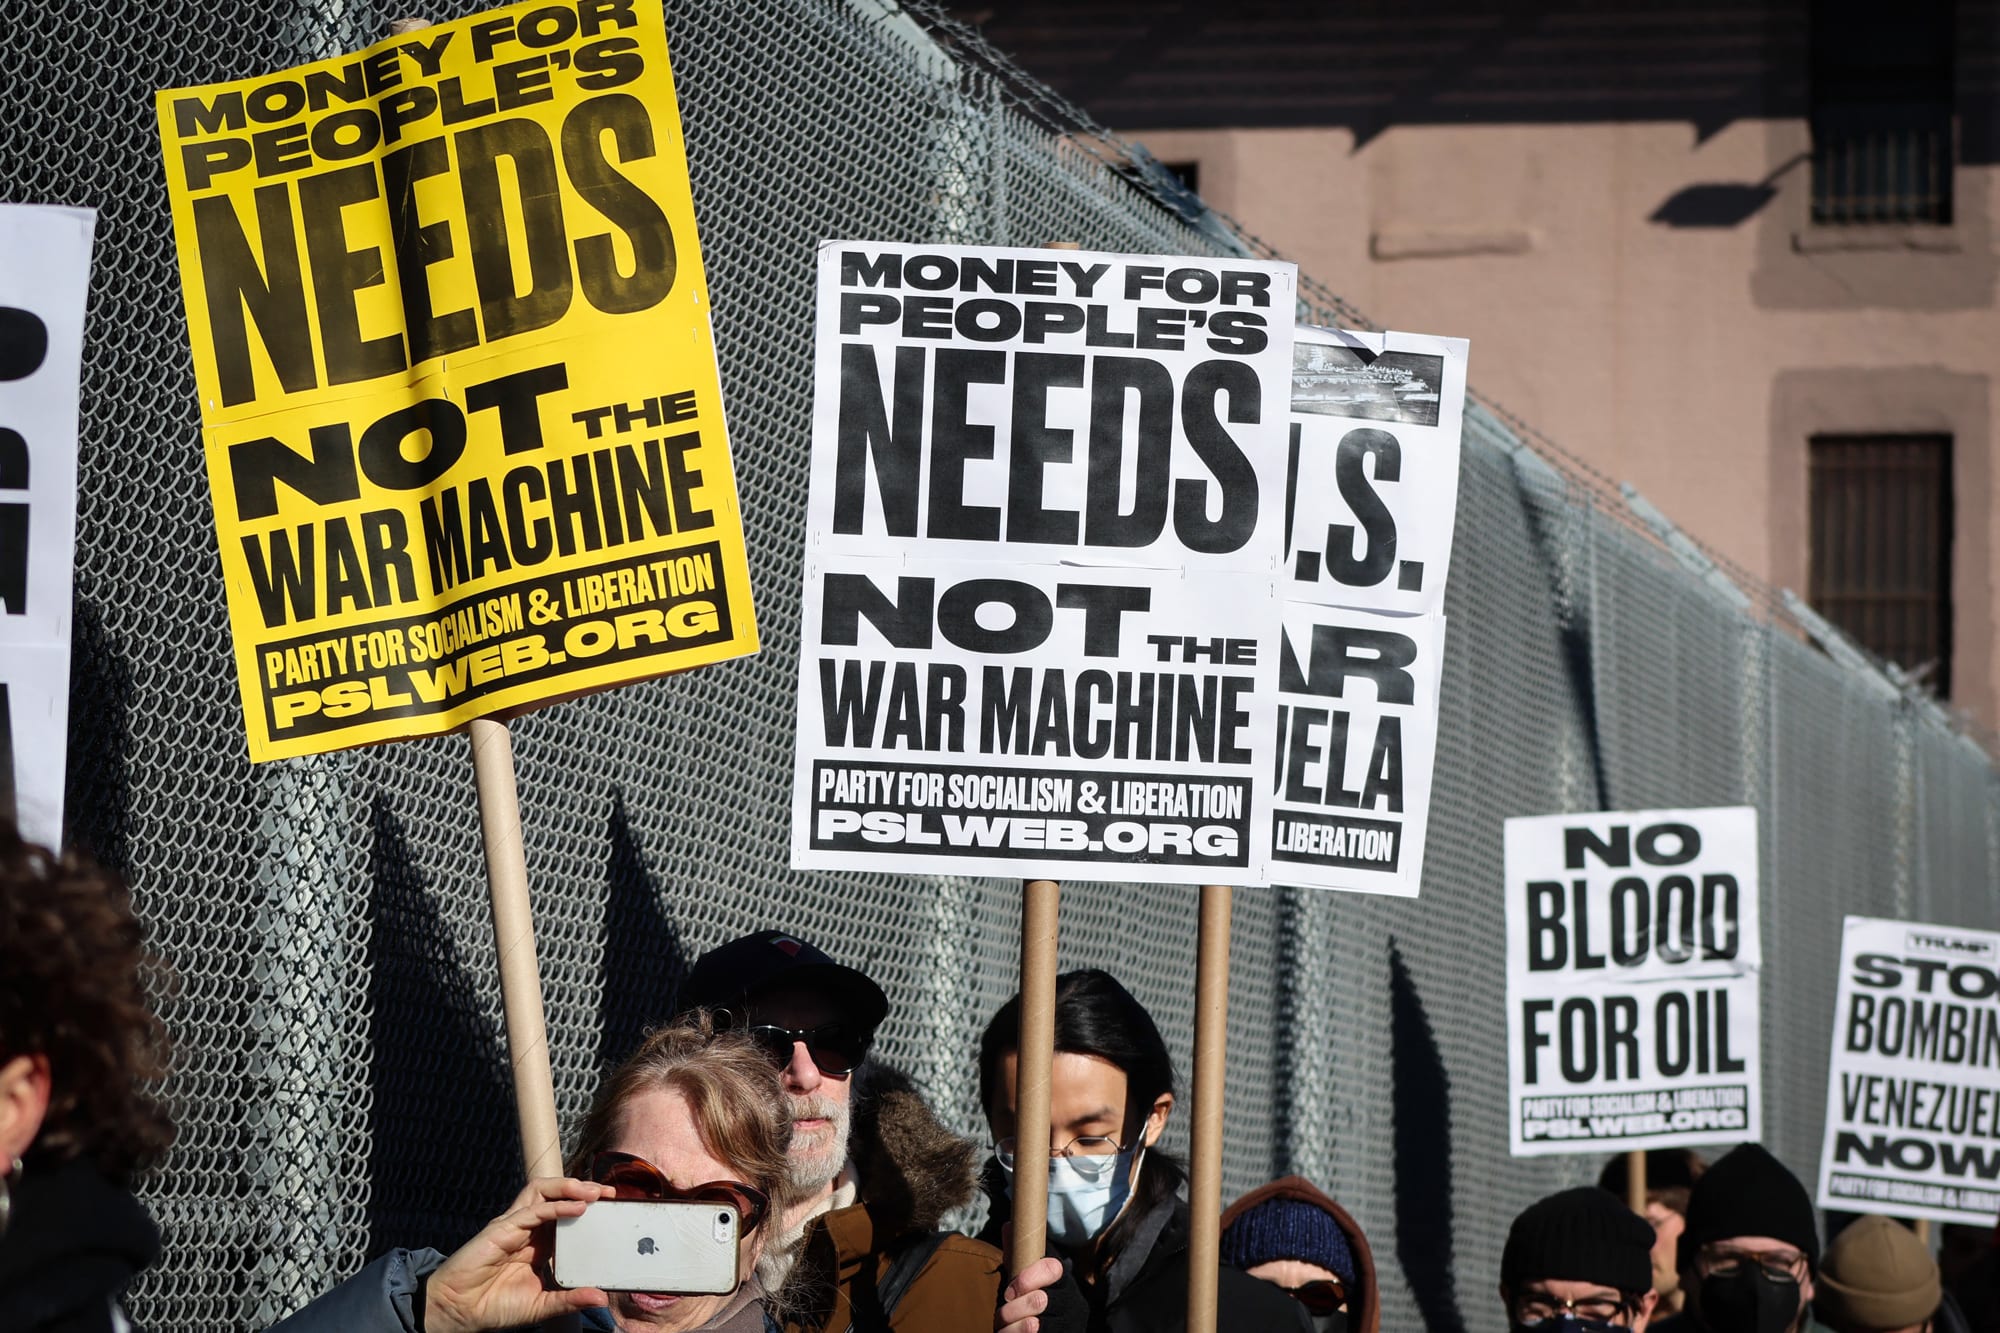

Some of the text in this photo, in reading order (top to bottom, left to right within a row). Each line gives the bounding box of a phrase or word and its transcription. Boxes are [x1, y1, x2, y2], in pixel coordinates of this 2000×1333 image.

[173, 0, 638, 138] MONEY FOR
[181, 37, 645, 191] PEOPLE'S
[192, 92, 678, 409] NEEDS
[840, 251, 1271, 307] MONEY FOR
[838, 295, 1269, 354] PEOPLE'S
[228, 362, 699, 522] NOT THE
[833, 344, 1262, 554] NEEDS
[240, 430, 715, 630] WAR MACHINE
[1284, 423, 1424, 592] .S.
[265, 553, 716, 689] PARTY FOR SOCIALISM & LIBERATION
[271, 600, 720, 730] PSLWEB.ORG
[820, 574, 1258, 666] NOT THE
[820, 658, 1255, 765] WAR MACHINE
[1274, 704, 1404, 814] ELA
[817, 809, 1240, 857] PSLWEB.ORG
[818, 768, 1243, 820] PARTY FOR SOCIALISM & LIBERATION
[1276, 820, 1394, 862] LIBERATION
[1564, 822, 1701, 869] NO
[1526, 873, 1740, 972] BLOOD
[1852, 953, 2000, 999] STO
[1522, 989, 1745, 1086] FOR OIL
[1524, 1109, 1746, 1139] PSLWEB.ORG
[1834, 1131, 2000, 1180] NOW
